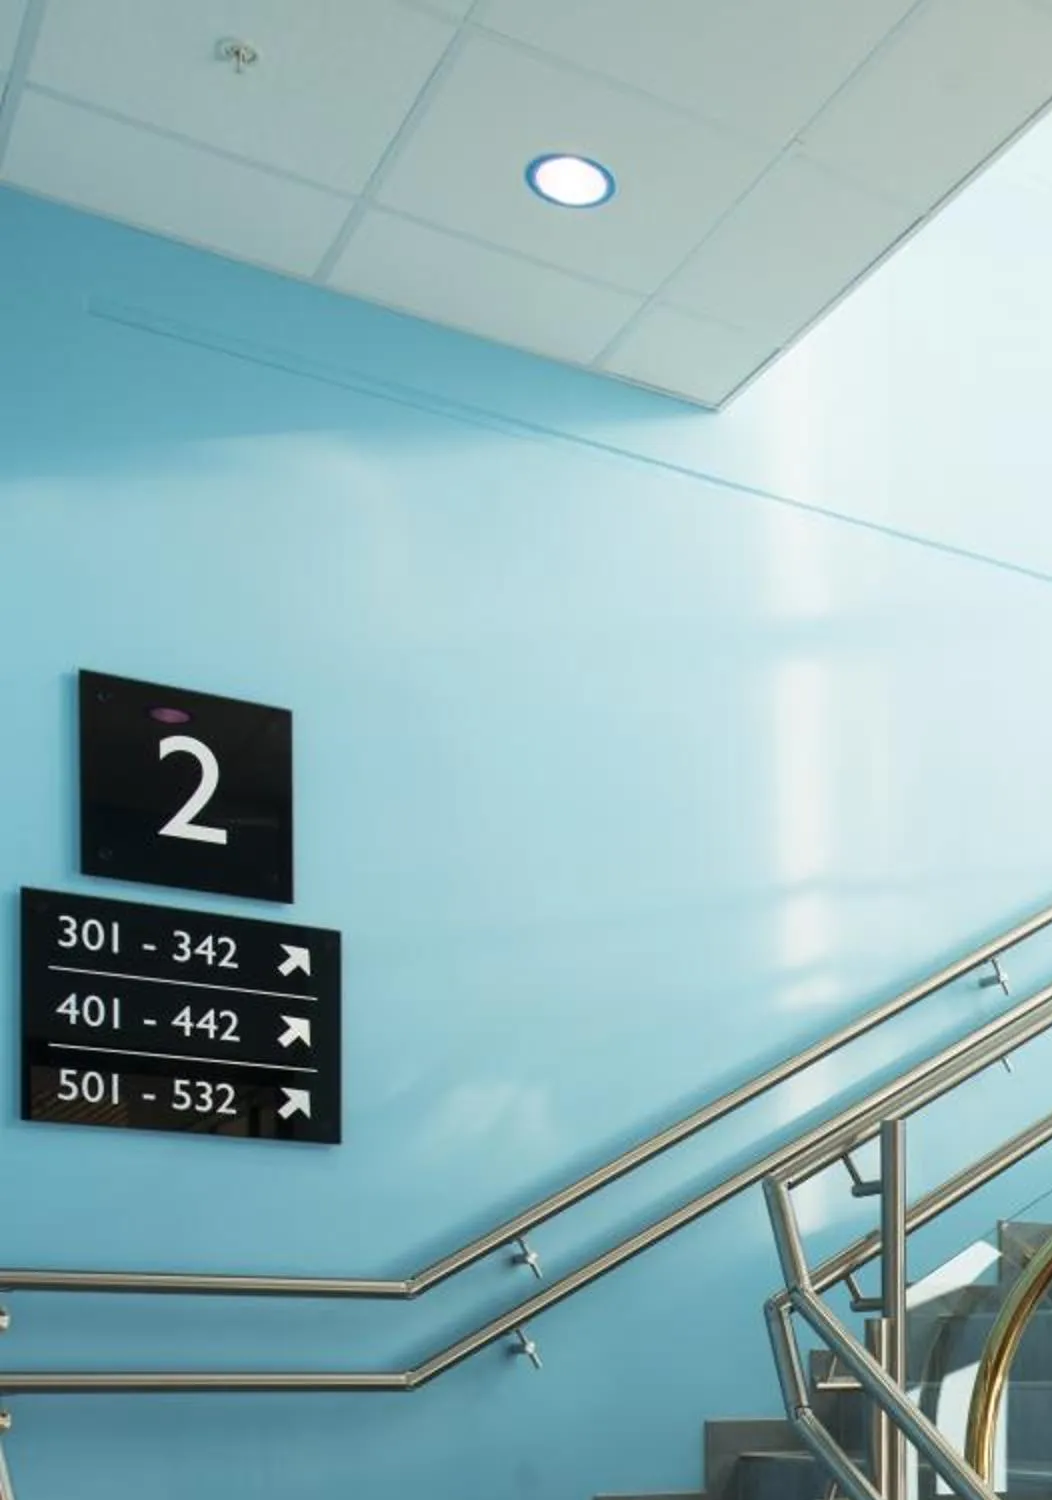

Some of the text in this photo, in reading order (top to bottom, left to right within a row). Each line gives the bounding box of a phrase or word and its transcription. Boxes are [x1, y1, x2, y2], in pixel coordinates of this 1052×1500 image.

[158, 735, 228, 845] 2
[58, 915, 120, 955] 301
[172, 930, 239, 969] 342
[55, 993, 121, 1030] 401
[171, 1005, 241, 1042] 442
[57, 1068, 120, 1105] 501
[172, 1079, 237, 1115] 532
